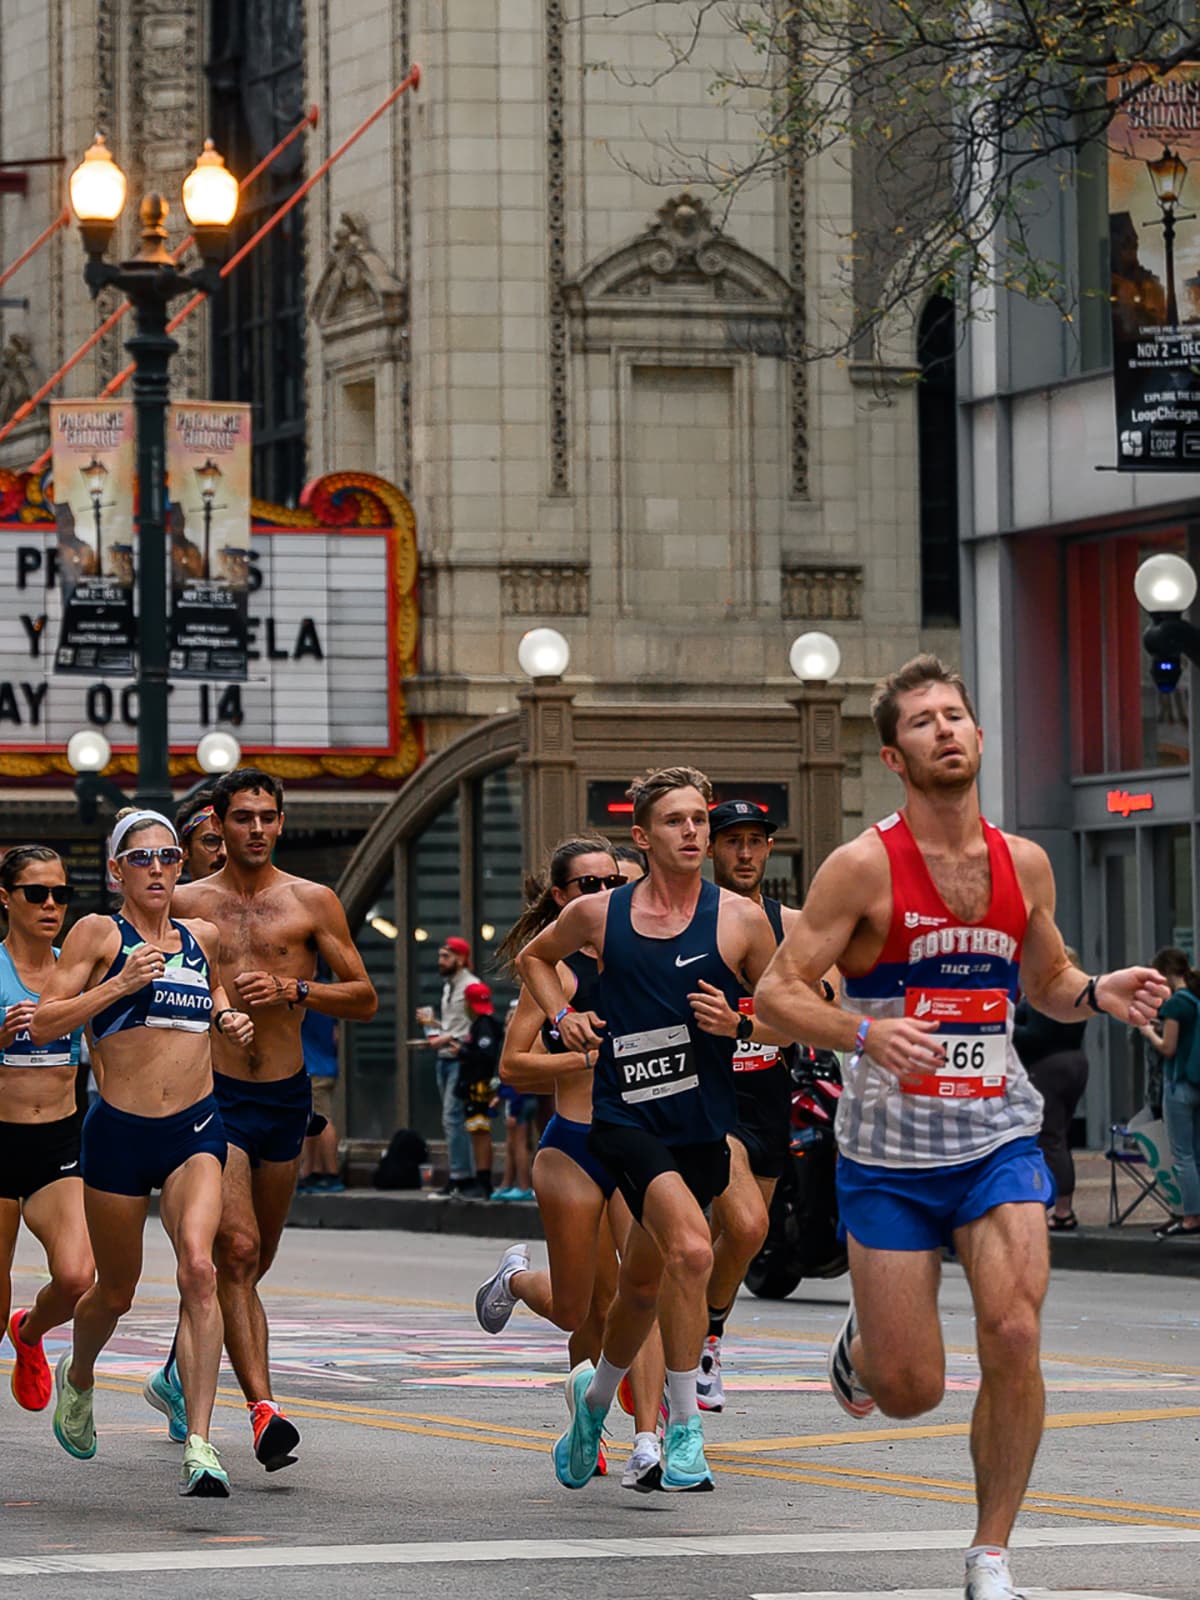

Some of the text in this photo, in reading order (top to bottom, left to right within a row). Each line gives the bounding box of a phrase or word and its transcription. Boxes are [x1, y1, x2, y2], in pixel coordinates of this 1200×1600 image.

[1137, 343, 1159, 357] NOV
[1161, 343, 1169, 357] 2
[1181, 341, 1200, 356] DEC
[25, 613, 49, 657] Y
[85, 683, 174, 727] OC
[200, 684, 244, 726] 14
[940, 963, 971, 975] TRACK
[154, 990, 213, 1010] D'AMATO
[623, 1053, 686, 1084] PACE 7
